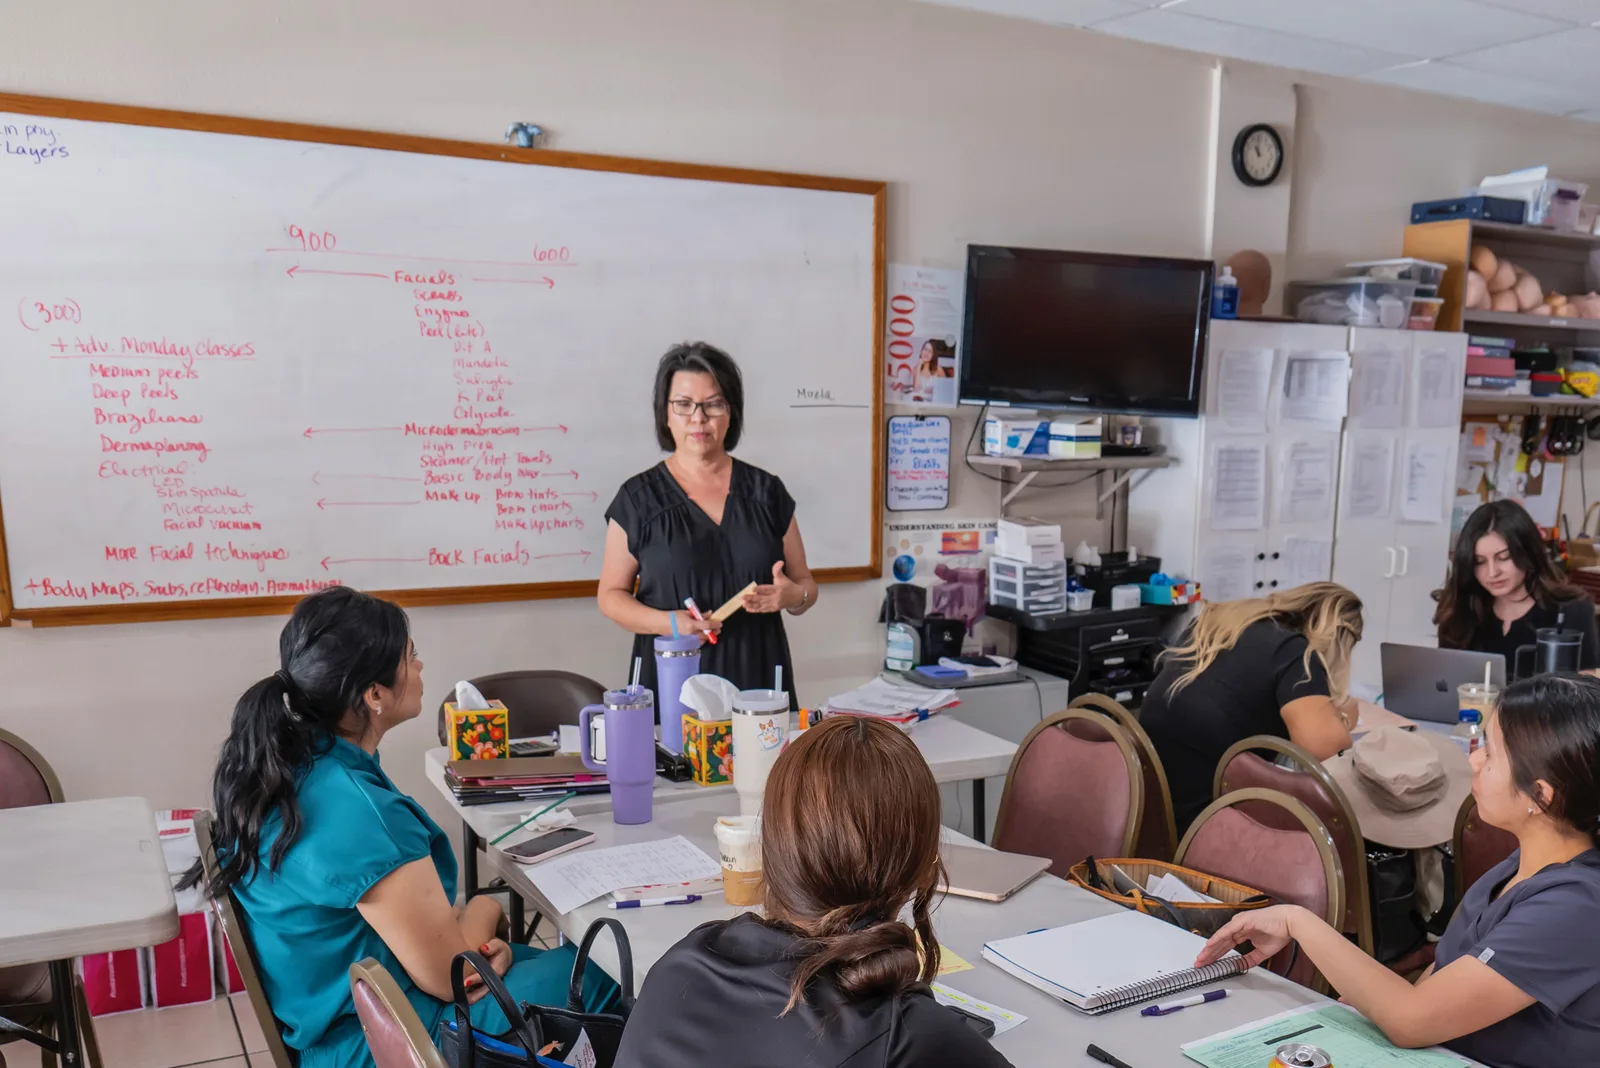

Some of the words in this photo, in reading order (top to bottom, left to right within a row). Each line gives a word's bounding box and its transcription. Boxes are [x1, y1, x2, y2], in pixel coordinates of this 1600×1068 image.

[6, 139, 70, 164] Layers
[289, 223, 336, 252] 900
[532, 246, 571, 262] 600
[394, 269, 456, 286] Facials
[18, 297, 82, 332] (300)
[120, 336, 193, 368] Monday
[483, 340, 492, 353] A
[886, 293, 917, 394] $5000
[423, 469, 465, 486] Basic
[889, 523, 955, 532] UNDERSTANDING
[957, 522, 976, 530] SKIN
[977, 522, 998, 530] CANC
[105, 545, 138, 561] More
[150, 542, 194, 562] Facial
[428, 547, 465, 567] Back
[473, 540, 531, 567] Facials
